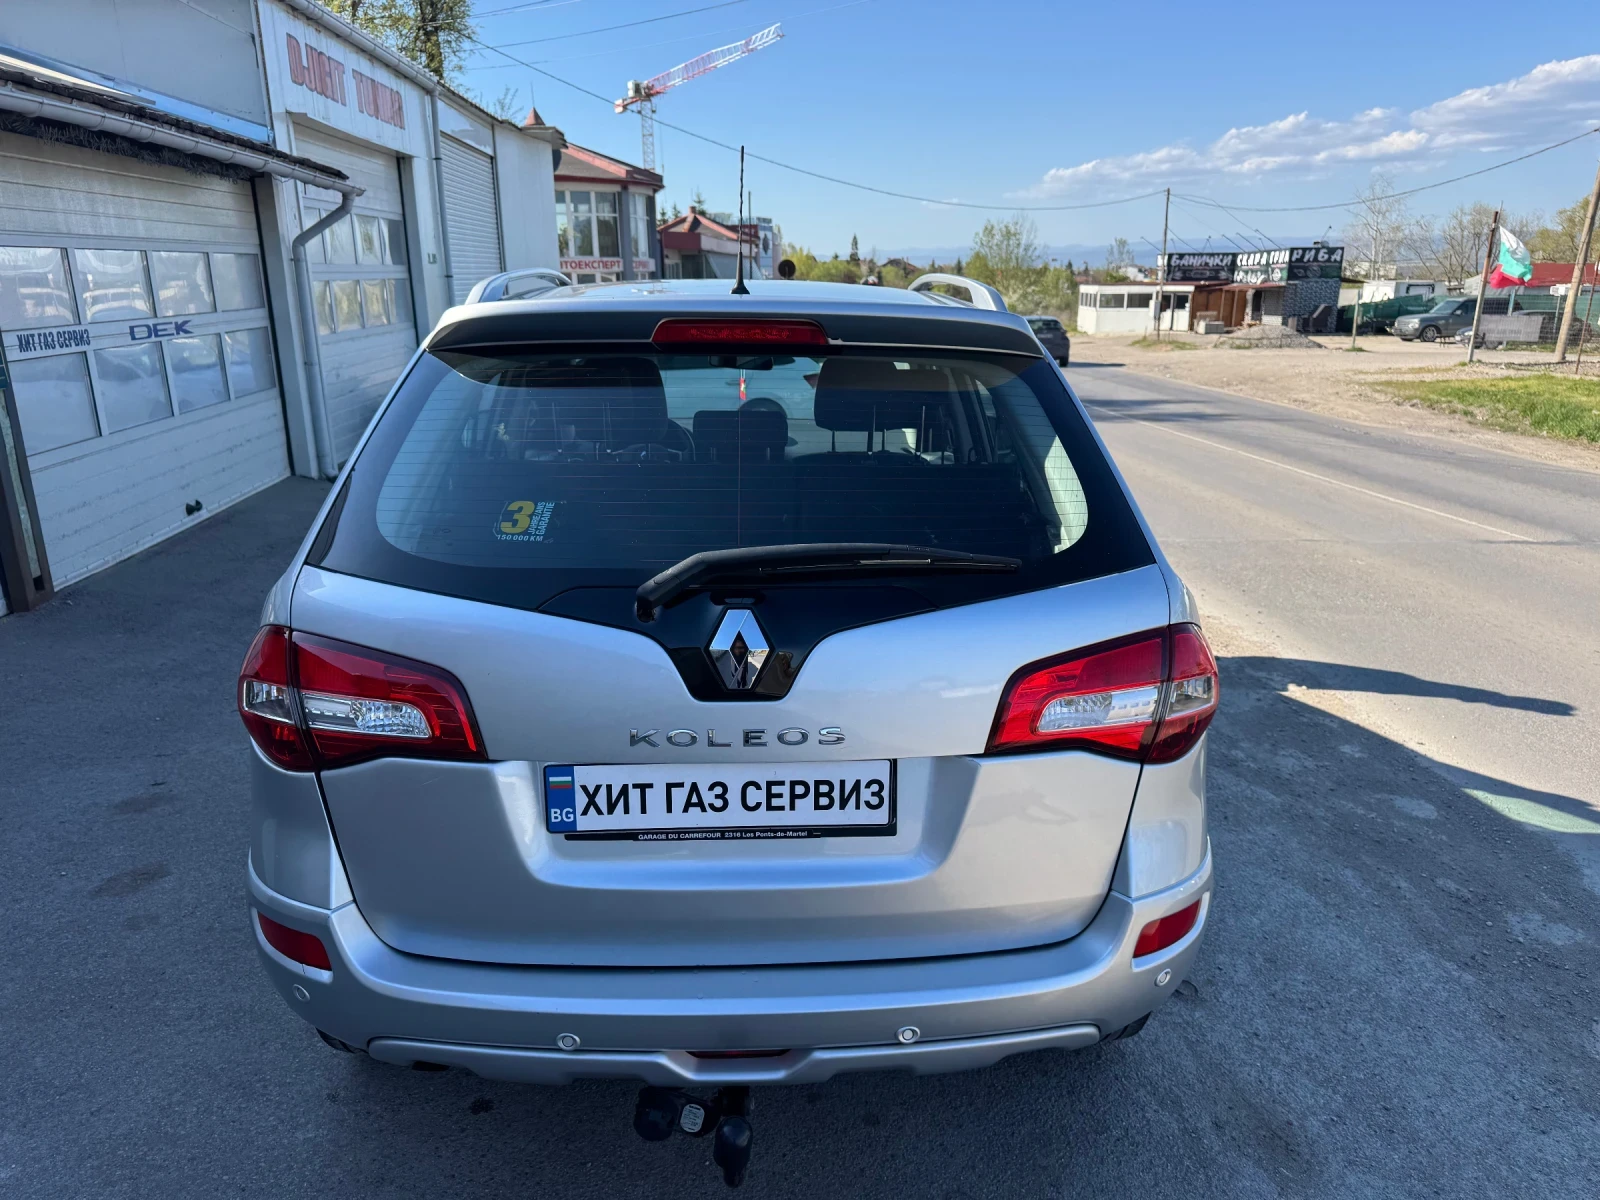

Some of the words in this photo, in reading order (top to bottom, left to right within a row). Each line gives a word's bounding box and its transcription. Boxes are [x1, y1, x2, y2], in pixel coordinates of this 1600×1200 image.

[560, 260, 621, 270] ТОЕКСПЕРТ
[1170, 253, 1233, 267] БАНИЧКИ
[1236, 251, 1268, 267] СКАРА
[1291, 248, 1343, 262] РИБА
[16, 333, 37, 353] ХИТ
[37, 331, 57, 351] ГАЗ
[57, 328, 92, 348] СЕРВИЗ
[129, 320, 195, 341] DEK
[500, 500, 535, 534] 3
[536, 502, 555, 535] GARANTIE
[628, 726, 848, 748] KOLEOS
[579, 783, 654, 817] ХИТ
[665, 780, 730, 814] ГАЗ
[739, 778, 886, 813] СЕРВИЗ
[550, 808, 575, 824] BG
